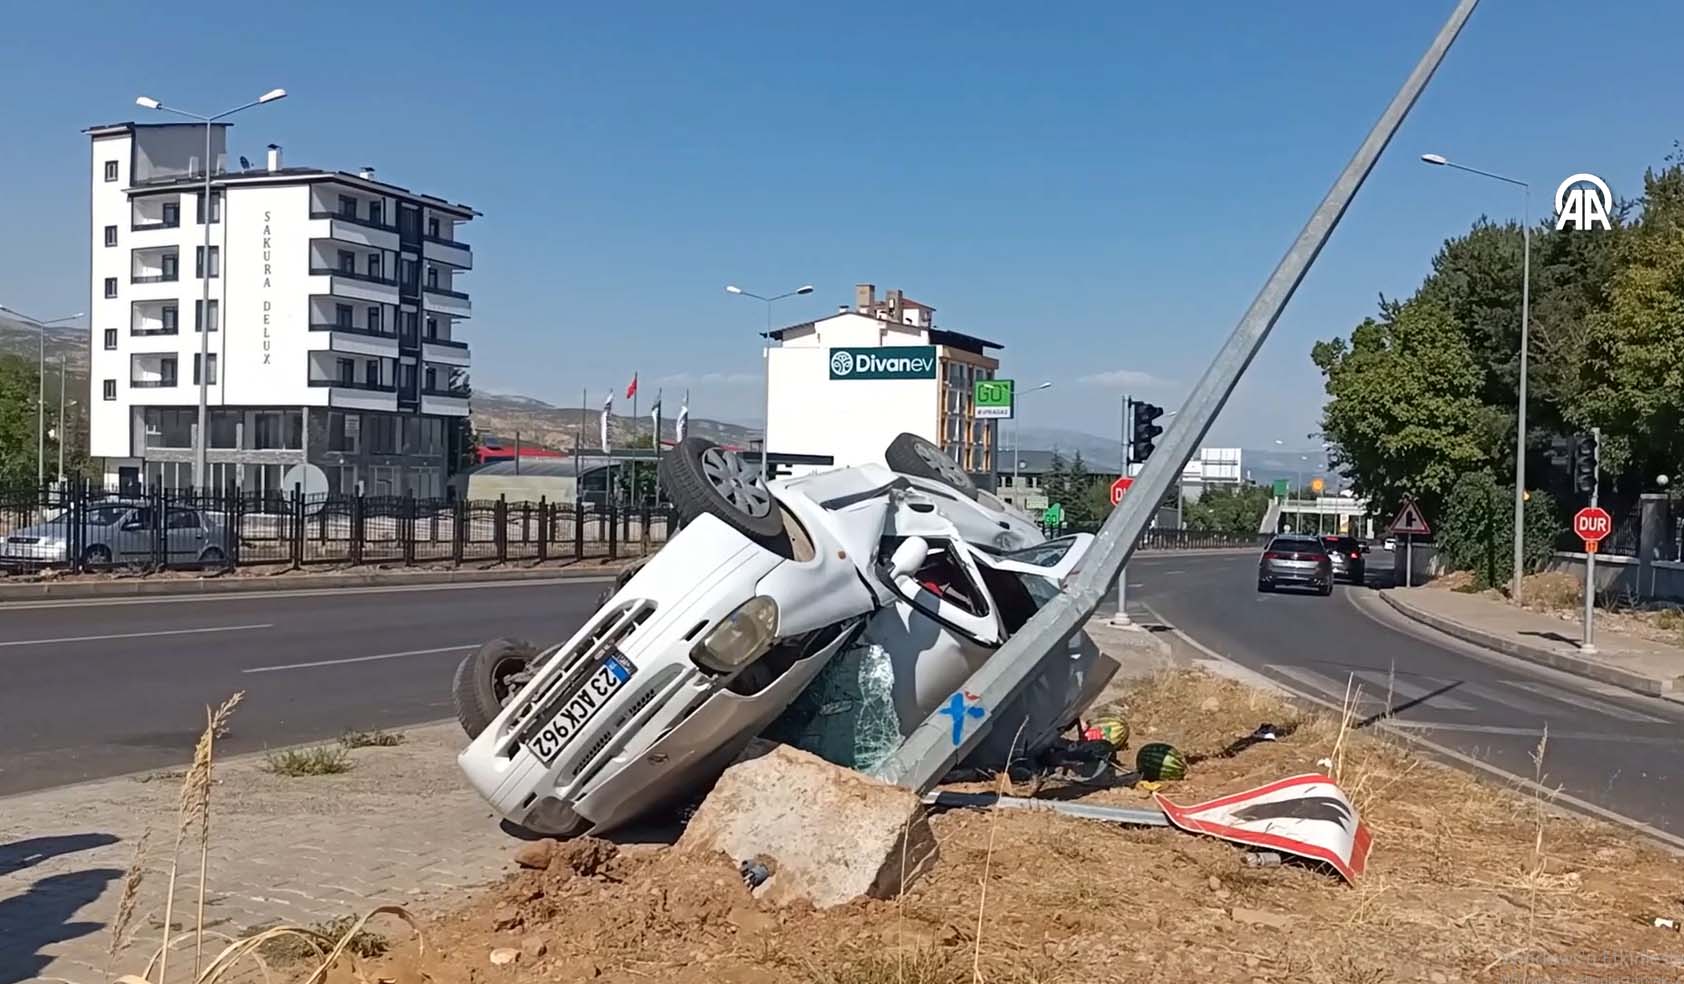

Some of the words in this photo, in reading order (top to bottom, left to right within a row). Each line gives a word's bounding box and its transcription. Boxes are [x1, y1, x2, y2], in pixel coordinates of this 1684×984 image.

[263, 211, 271, 287] SAKURA
[263, 301, 271, 364] DELUX
[856, 354, 933, 372] Divanev
[1579, 516, 1606, 532] DUR
[591, 668, 617, 696] 23
[560, 689, 596, 729] ACK
[533, 721, 569, 756] 962
